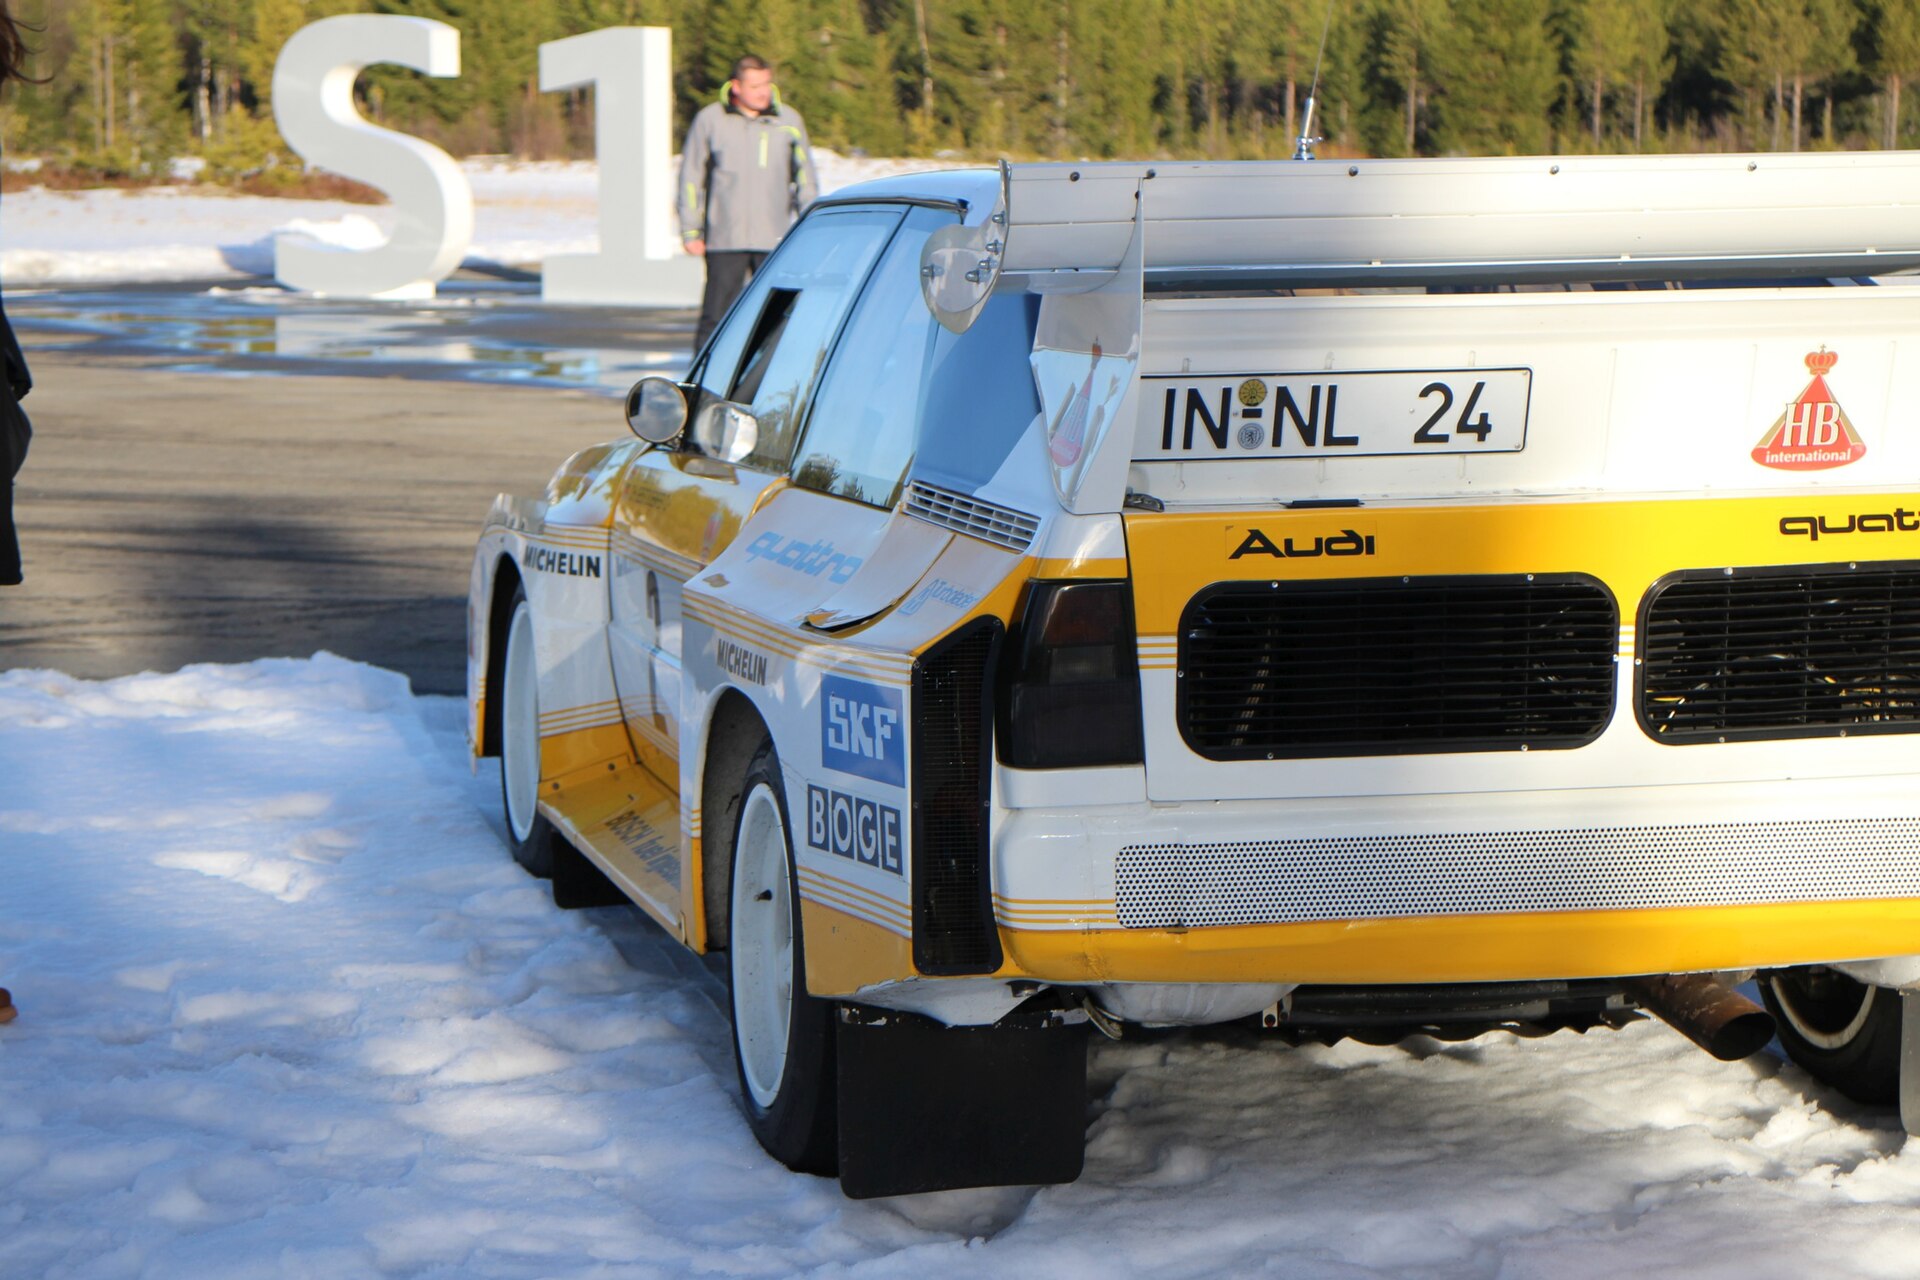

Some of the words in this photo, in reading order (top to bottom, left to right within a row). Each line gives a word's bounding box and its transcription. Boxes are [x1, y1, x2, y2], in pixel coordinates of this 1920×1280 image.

[1413, 381, 1493, 443] 24
[1782, 402, 1841, 447] HB
[1765, 449, 1852, 464] international
[1228, 528, 1375, 560] Audi
[1779, 507, 1920, 541] quat
[523, 545, 601, 578] MICHELIN
[745, 531, 864, 585] quattro
[716, 638, 767, 686] MICHELIN
[828, 694, 898, 761] SKF
[811, 788, 899, 870] BOGE
